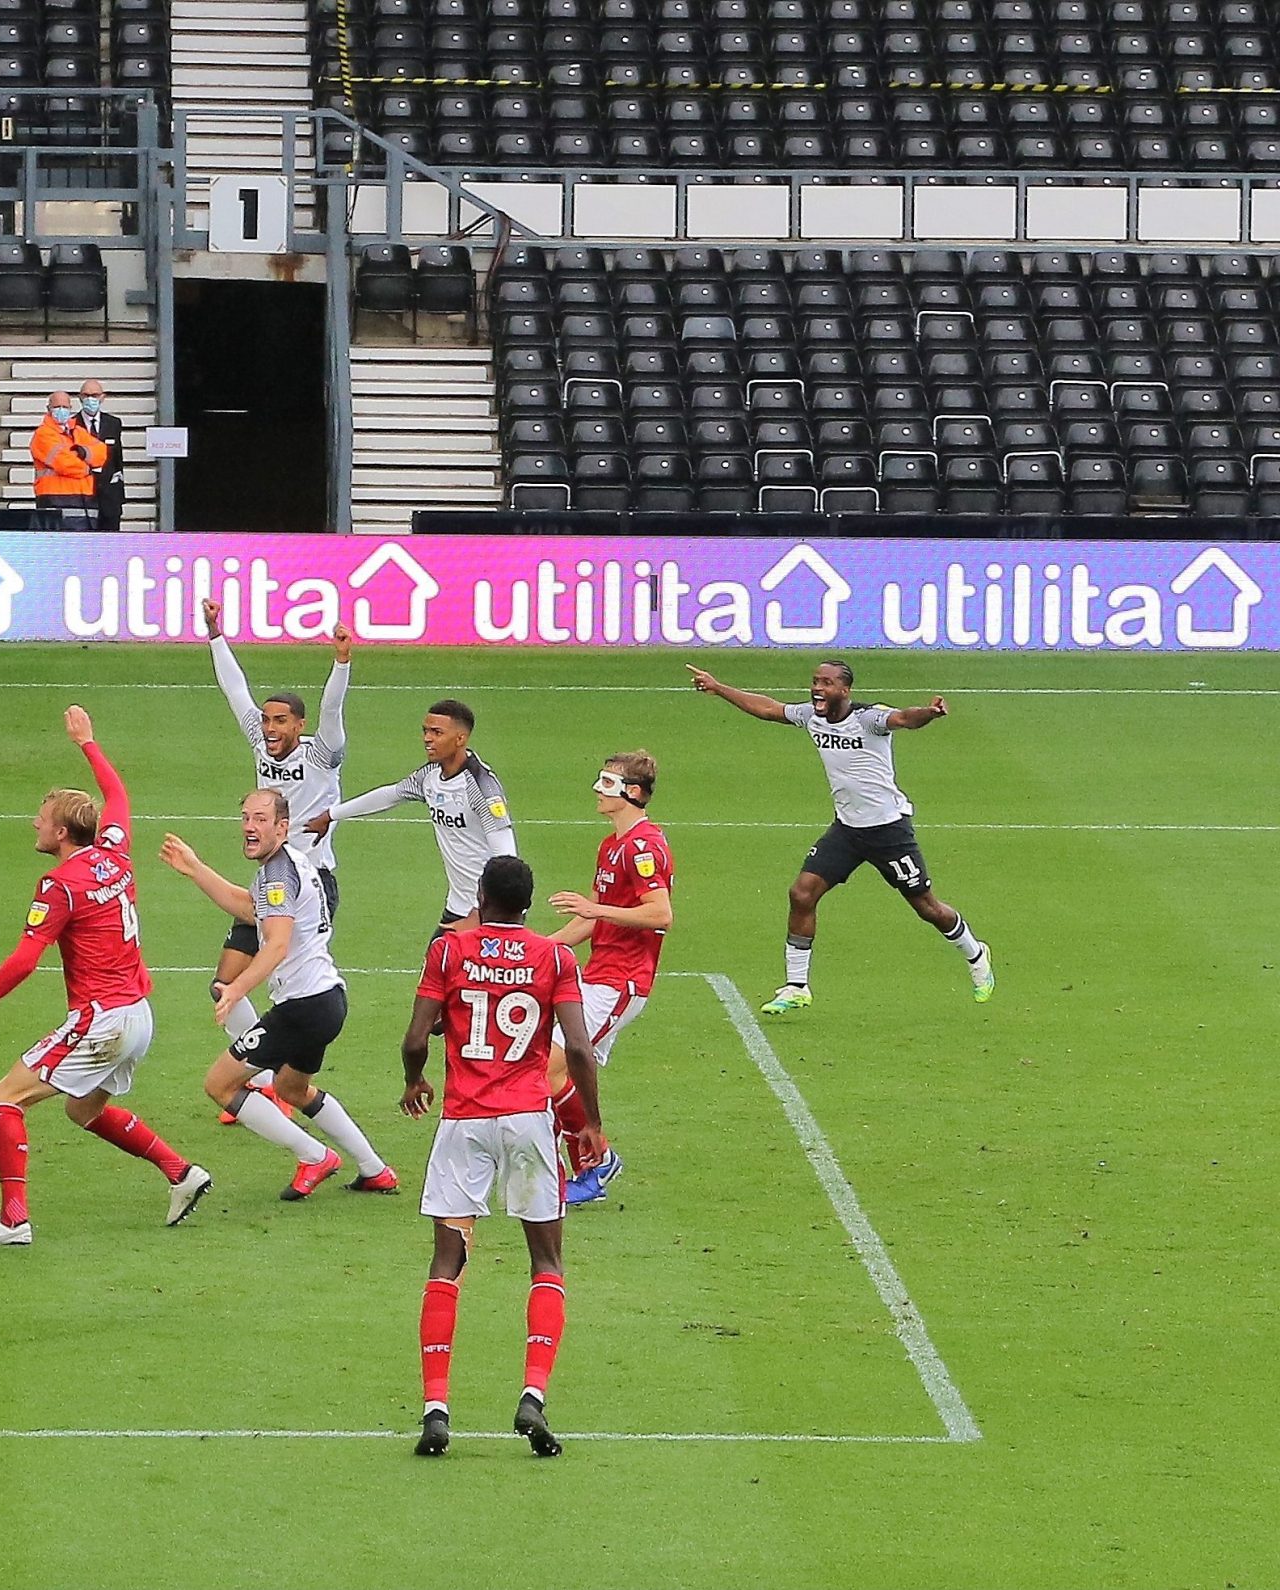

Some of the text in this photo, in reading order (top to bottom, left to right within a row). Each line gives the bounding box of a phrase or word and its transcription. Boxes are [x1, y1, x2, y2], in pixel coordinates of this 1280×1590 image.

[238, 188, 259, 240] 1
[63, 555, 343, 640] utilita
[473, 559, 754, 643] utilita
[882, 562, 1164, 647] utilita
[813, 733, 864, 750] 32Red
[259, 759, 304, 781] 2Red
[430, 806, 467, 829] 2Red
[888, 854, 921, 881] 11
[118, 891, 141, 949] 4
[504, 939, 526, 955] UK
[468, 965, 535, 985] AMEOBI
[460, 989, 541, 1062] 19
[423, 1344, 450, 1353] NFFC
